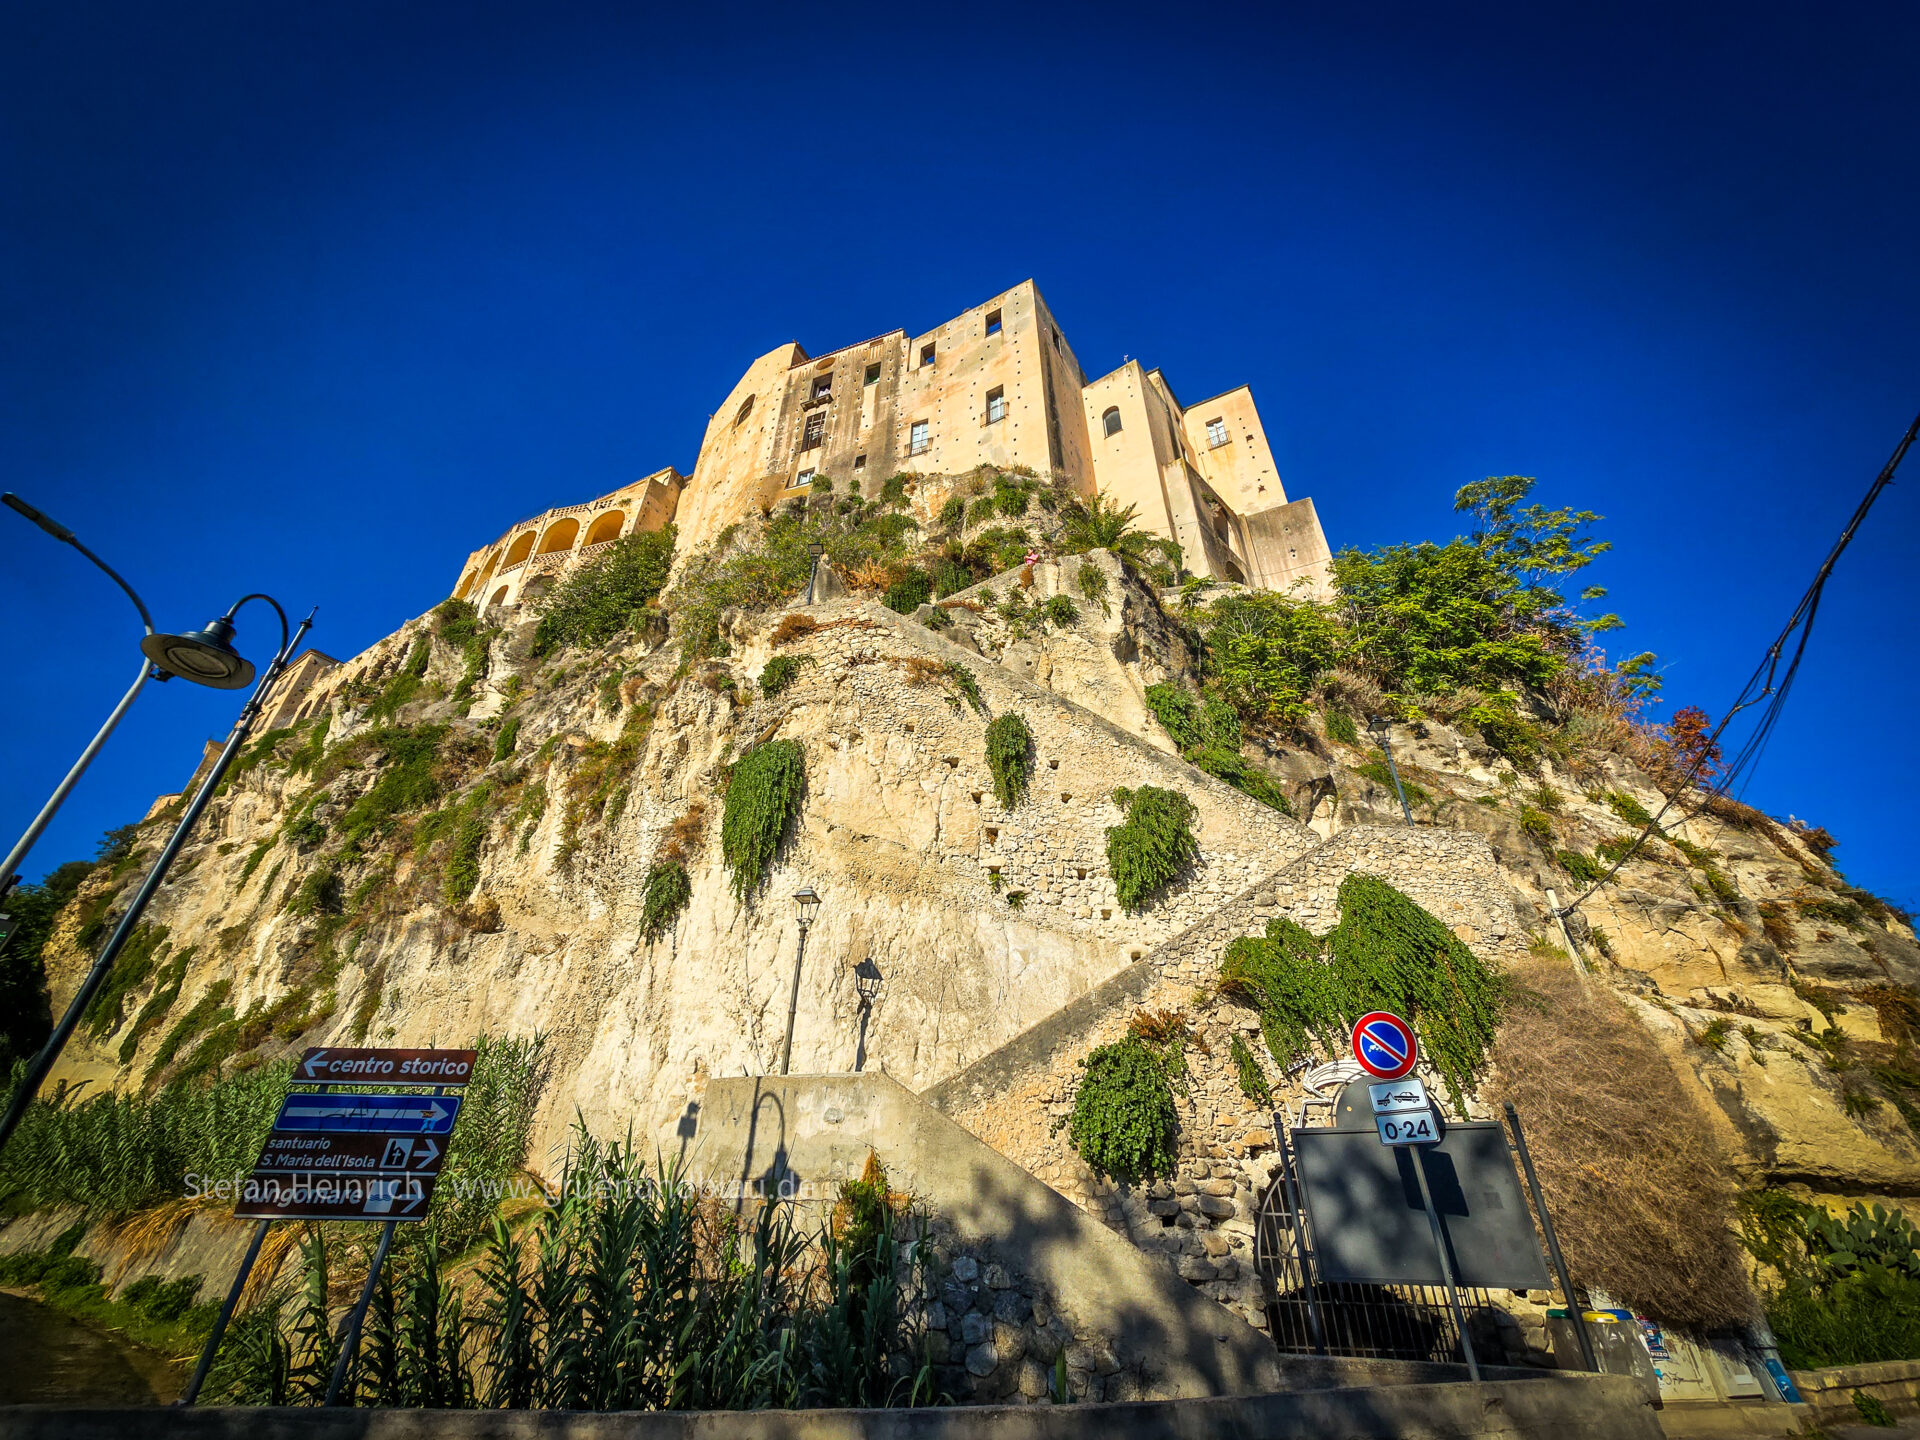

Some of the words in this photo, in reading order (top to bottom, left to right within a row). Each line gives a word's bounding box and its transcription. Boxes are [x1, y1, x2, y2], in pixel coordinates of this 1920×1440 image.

[329, 1056, 394, 1075] centro
[400, 1057, 469, 1076] storico
[1384, 1119, 1431, 1140] 0-24
[268, 1136, 331, 1150] santuario
[260, 1153, 273, 1166] S.
[274, 1153, 312, 1167] Maria
[314, 1154, 376, 1168] dell'Isola
[243, 1182, 364, 1208] lungomare
